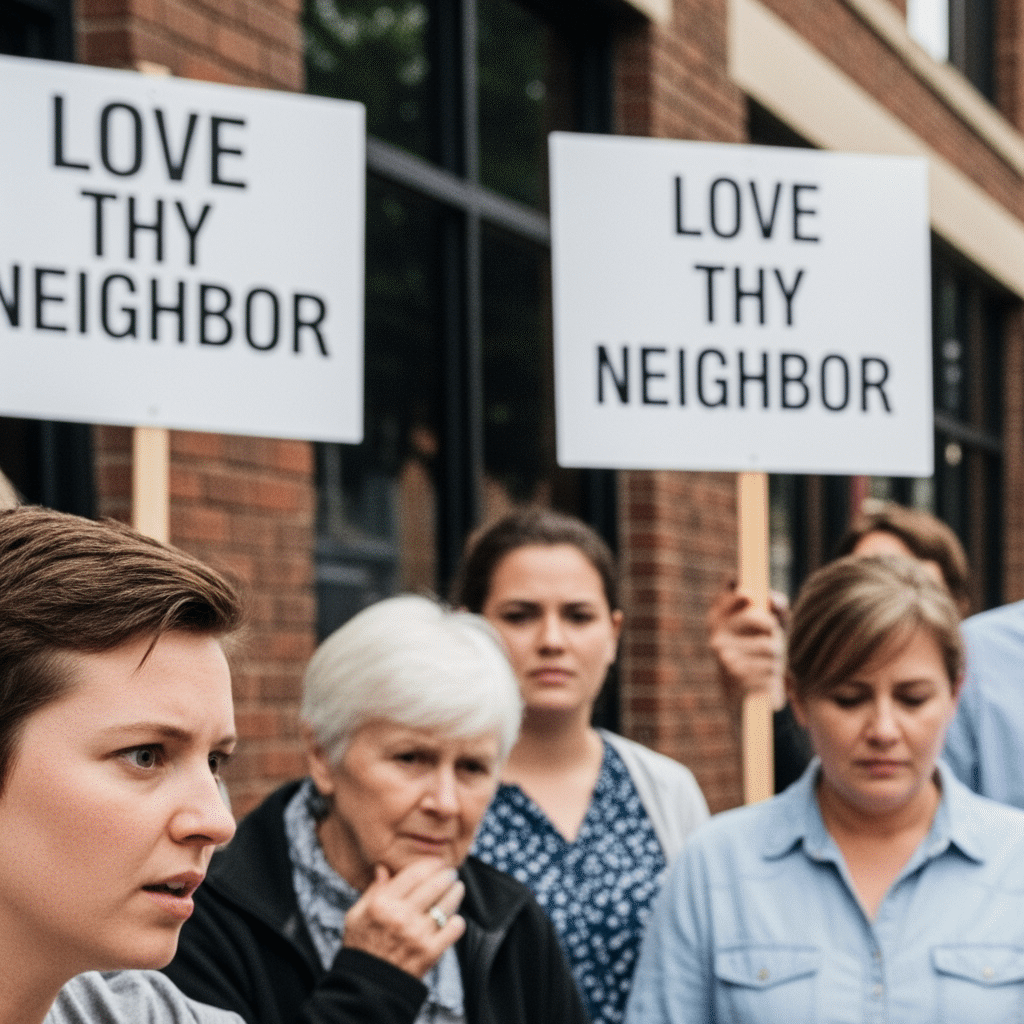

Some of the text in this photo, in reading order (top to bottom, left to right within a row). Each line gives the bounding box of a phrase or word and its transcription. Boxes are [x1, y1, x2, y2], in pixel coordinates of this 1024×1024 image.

[53, 94, 247, 189] LOVE
[80, 190, 212, 267] THY
[674, 176, 819, 243] LOVE
[694, 264, 805, 326] THY
[596, 345, 892, 413] NEIGHBOR
